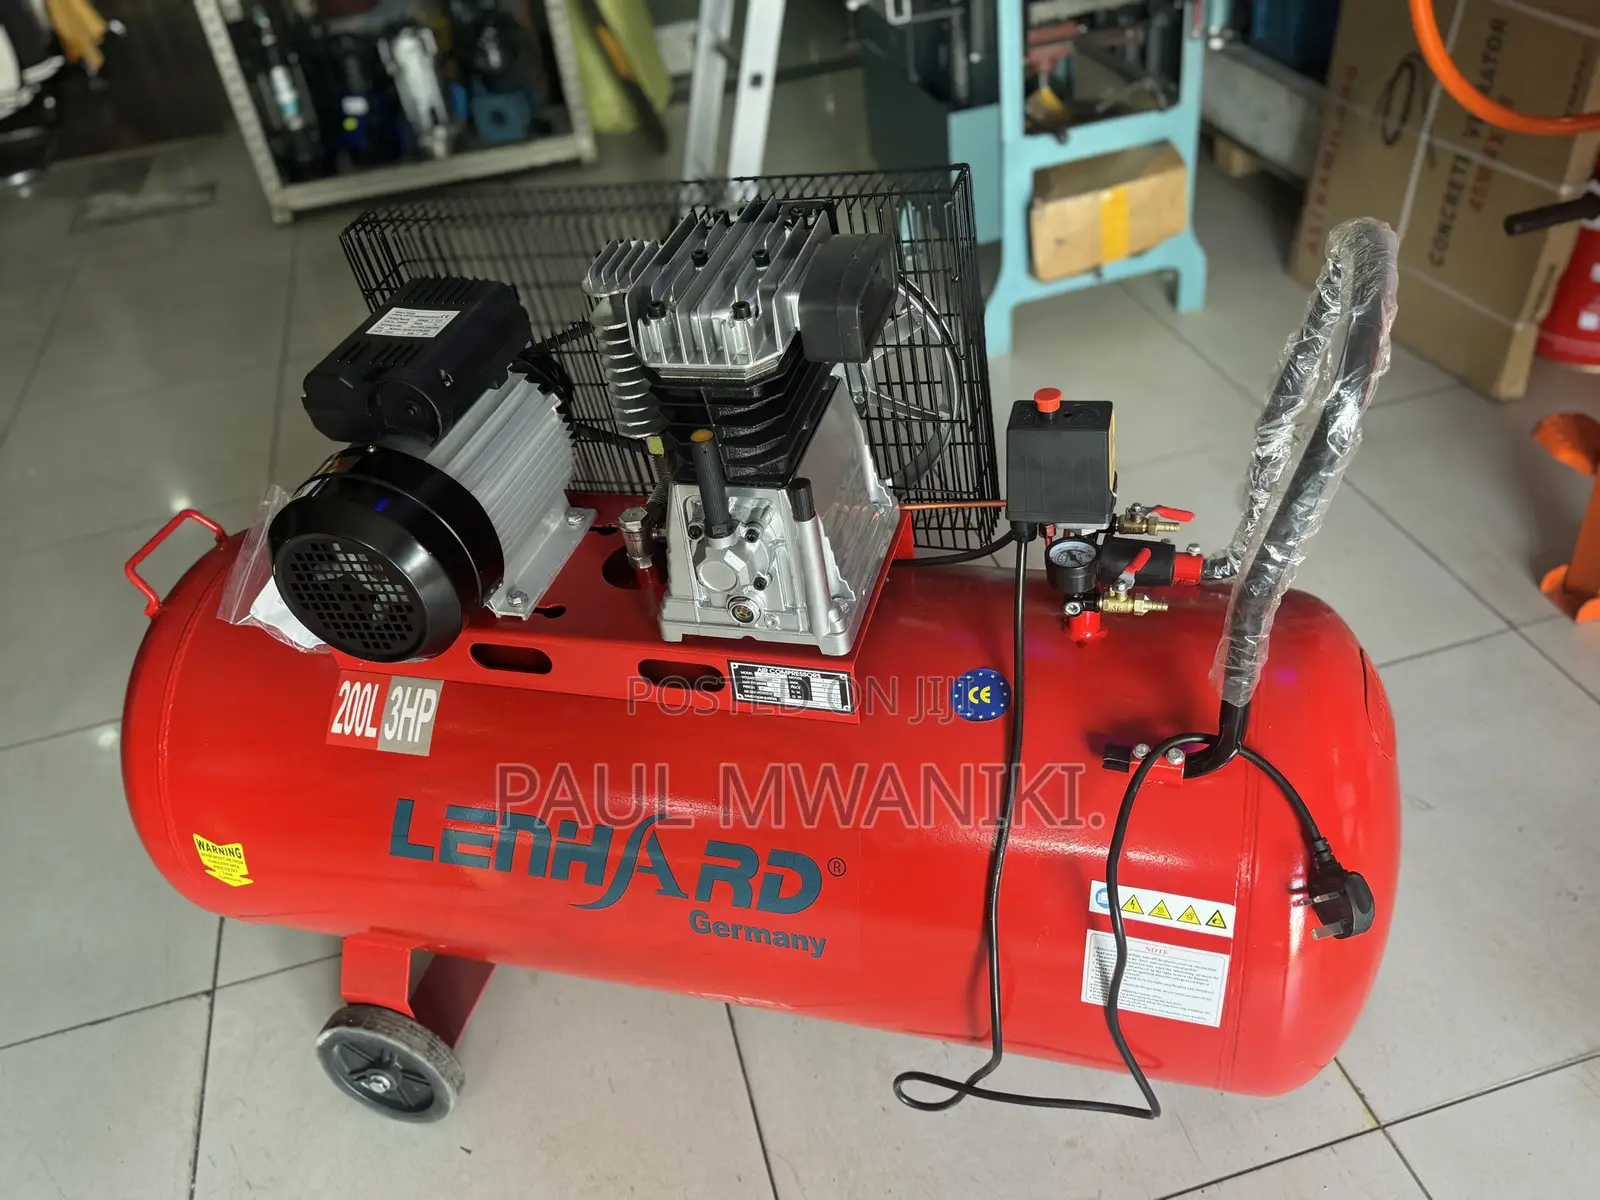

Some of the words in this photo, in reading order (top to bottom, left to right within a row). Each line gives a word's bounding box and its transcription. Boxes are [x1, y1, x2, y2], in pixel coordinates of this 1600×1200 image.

[1462, 17, 1508, 138] VIRATOR
[331, 680, 380, 738] 200L
[384, 686, 437, 743] 3HP
[968, 686, 991, 704] CE
[196, 838, 242, 859] WARNING
[689, 910, 827, 958] Germany
[1145, 946, 1169, 955] NOTE
